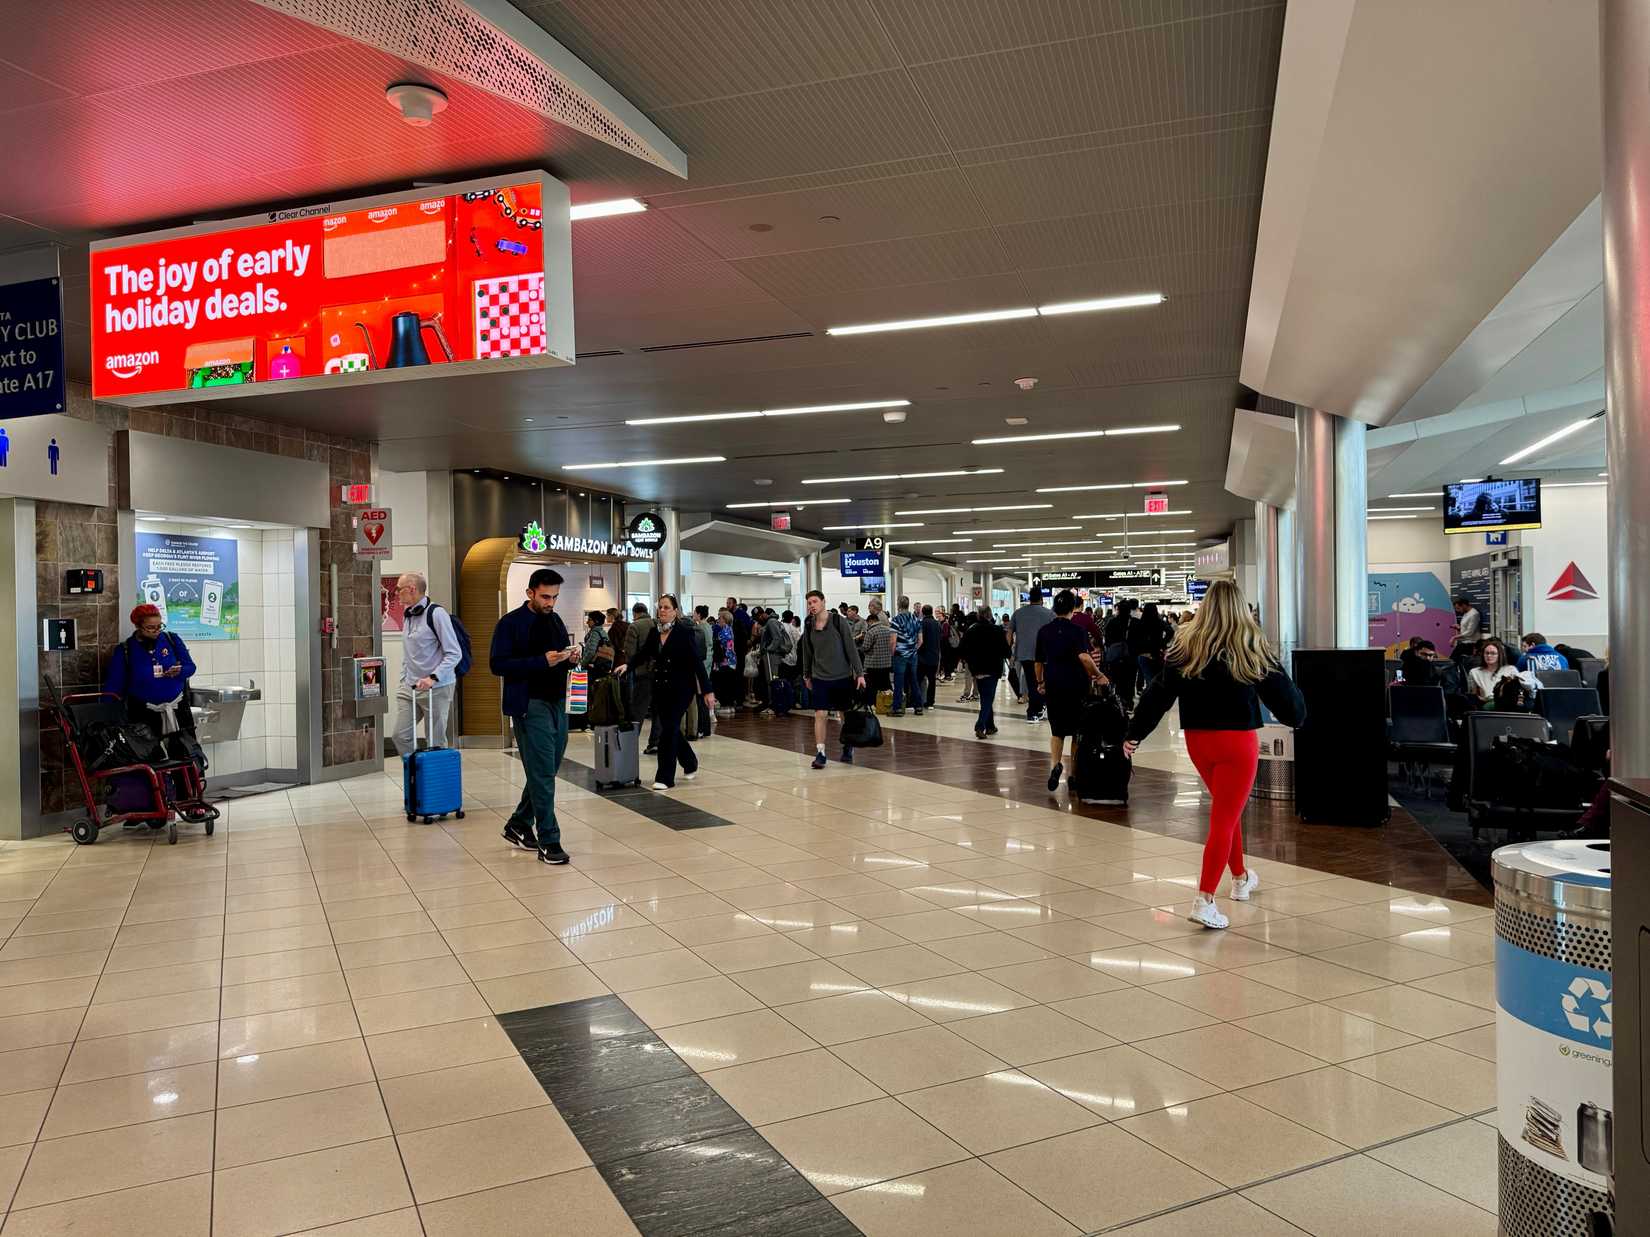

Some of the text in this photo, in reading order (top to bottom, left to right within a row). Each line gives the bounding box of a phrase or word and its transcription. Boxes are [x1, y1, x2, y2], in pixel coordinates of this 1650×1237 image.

[278, 205, 331, 220] Clear Channel
[368, 207, 397, 220] amazon
[104, 239, 310, 296] The joy of early
[105, 282, 288, 333] holiday deals.
[15, 318, 58, 340] CLUB
[19, 349, 37, 365] to
[106, 350, 160, 370] amazon
[23, 370, 54, 391] A17
[361, 511, 387, 520] AED
[549, 534, 608, 555] SAMBAZON
[864, 537, 883, 549] A9
[845, 558, 879, 566] Houston
[1572, 1050, 1612, 1066] greening
